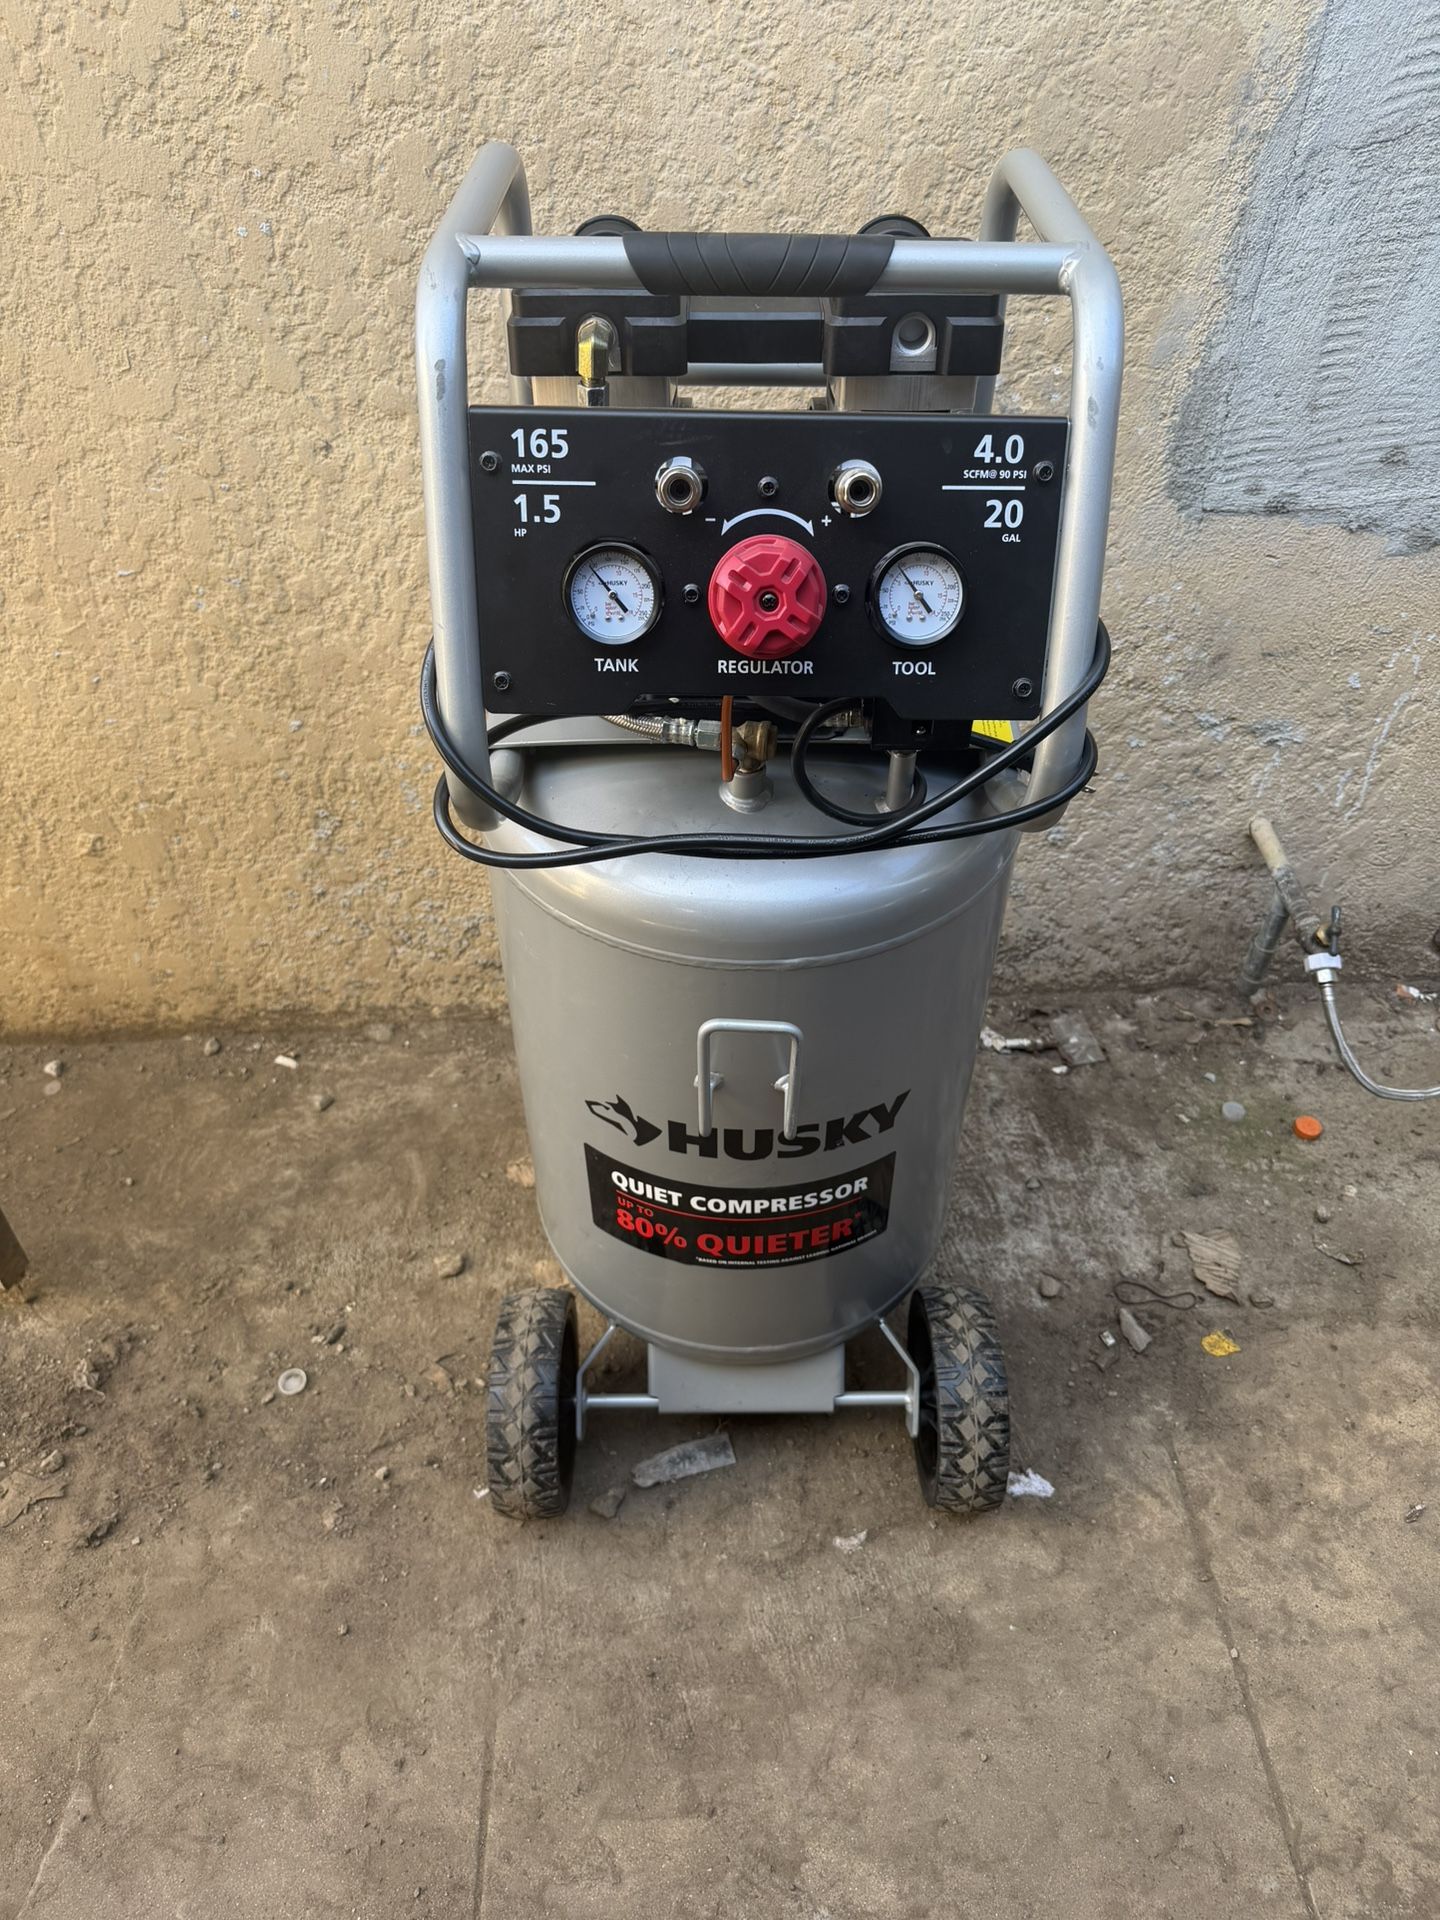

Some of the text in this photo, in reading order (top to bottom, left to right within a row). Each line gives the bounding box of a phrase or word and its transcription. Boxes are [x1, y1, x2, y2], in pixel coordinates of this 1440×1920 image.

[511, 428, 569, 459] 165
[973, 434, 1025, 464] 4.0
[511, 463, 551, 474] MAX PSI
[963, 469, 1028, 480] SCFM@ 90 PSI
[513, 493, 561, 524] 1.5
[983, 499, 1024, 529] 20
[513, 527, 528, 537] HP
[1001, 533, 1021, 543] GAL
[593, 657, 639, 673] TANK
[717, 659, 814, 675] REGULATOR
[892, 661, 937, 676] TOOL
[668, 1088, 911, 1161] HUSKY
[611, 1170, 868, 1215] QUIET COMPRESSOR
[617, 1196, 654, 1218] UP TO
[616, 1208, 687, 1249] 80%
